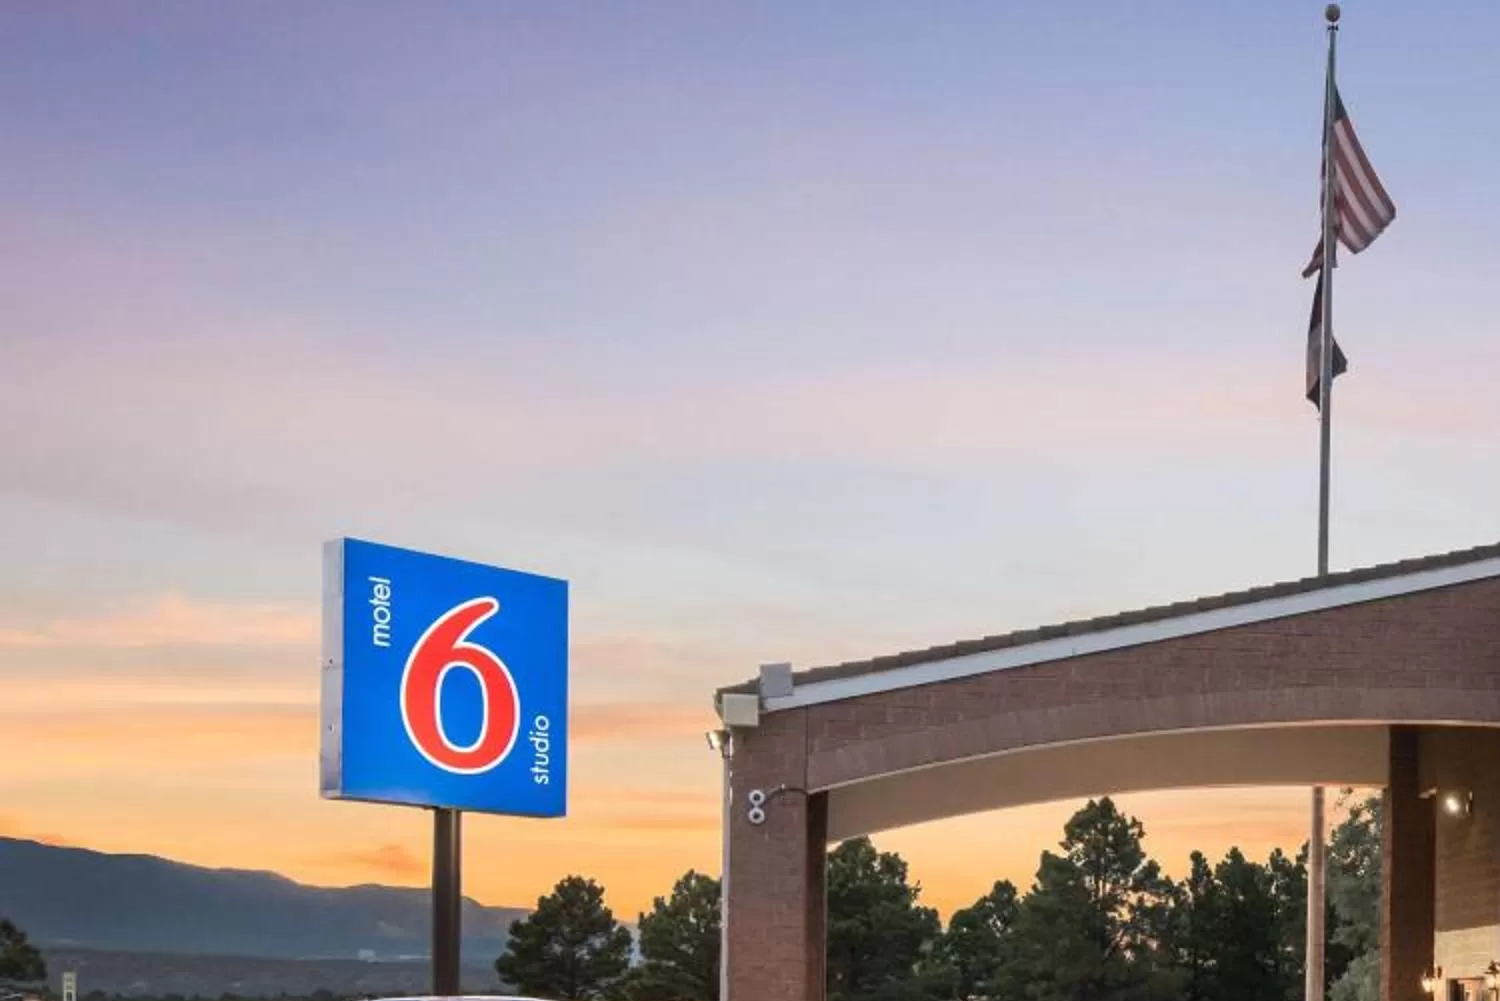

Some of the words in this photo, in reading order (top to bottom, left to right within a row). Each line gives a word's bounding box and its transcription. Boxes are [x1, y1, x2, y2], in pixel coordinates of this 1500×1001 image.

[368, 576, 391, 647] motel
[400, 596, 521, 775] 6
[529, 715, 549, 785] studio
